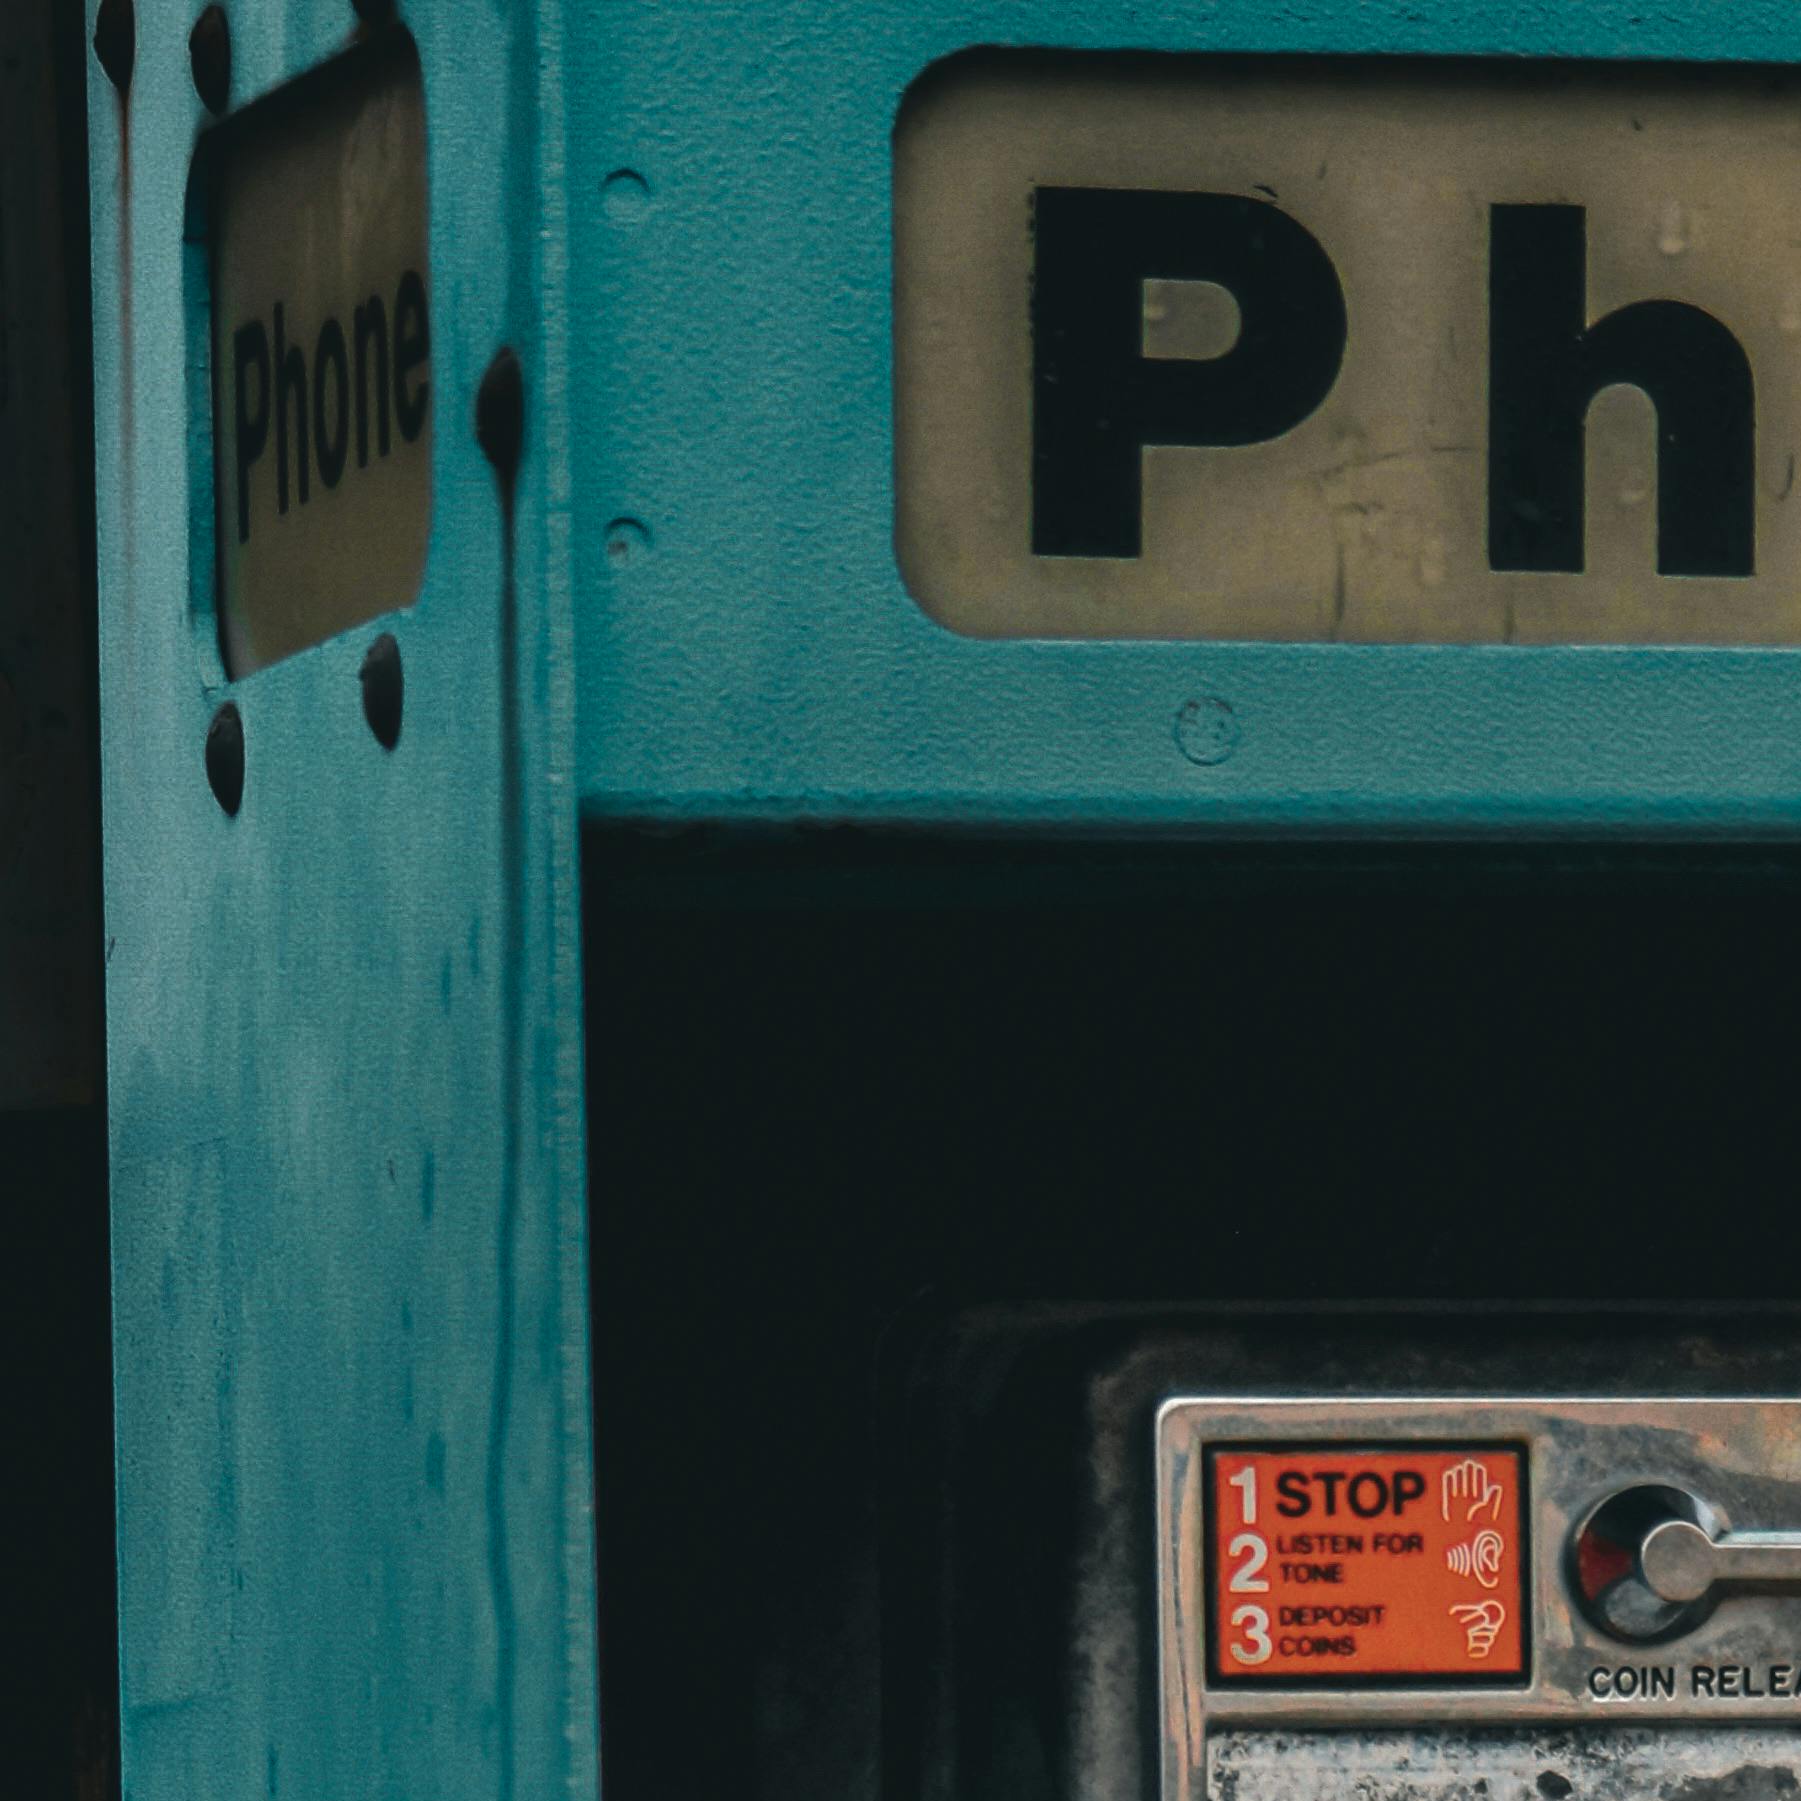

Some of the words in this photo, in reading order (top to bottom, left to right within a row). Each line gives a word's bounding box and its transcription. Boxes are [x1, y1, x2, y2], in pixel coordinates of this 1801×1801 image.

[233, 269, 430, 545] Phone
[1230, 1466, 1256, 1524] 1
[1275, 1471, 1425, 1518] STOP
[1229, 1533, 1270, 1593] 2
[1276, 1535, 1363, 1555] LISTEN
[1373, 1535, 1425, 1555] FOR
[1279, 1563, 1343, 1584] TONE
[1231, 1604, 1272, 1665] 3
[1278, 1606, 1385, 1626] DEPOSIT
[1278, 1636, 1357, 1657] COINS
[1588, 1665, 1675, 1699] COIN
